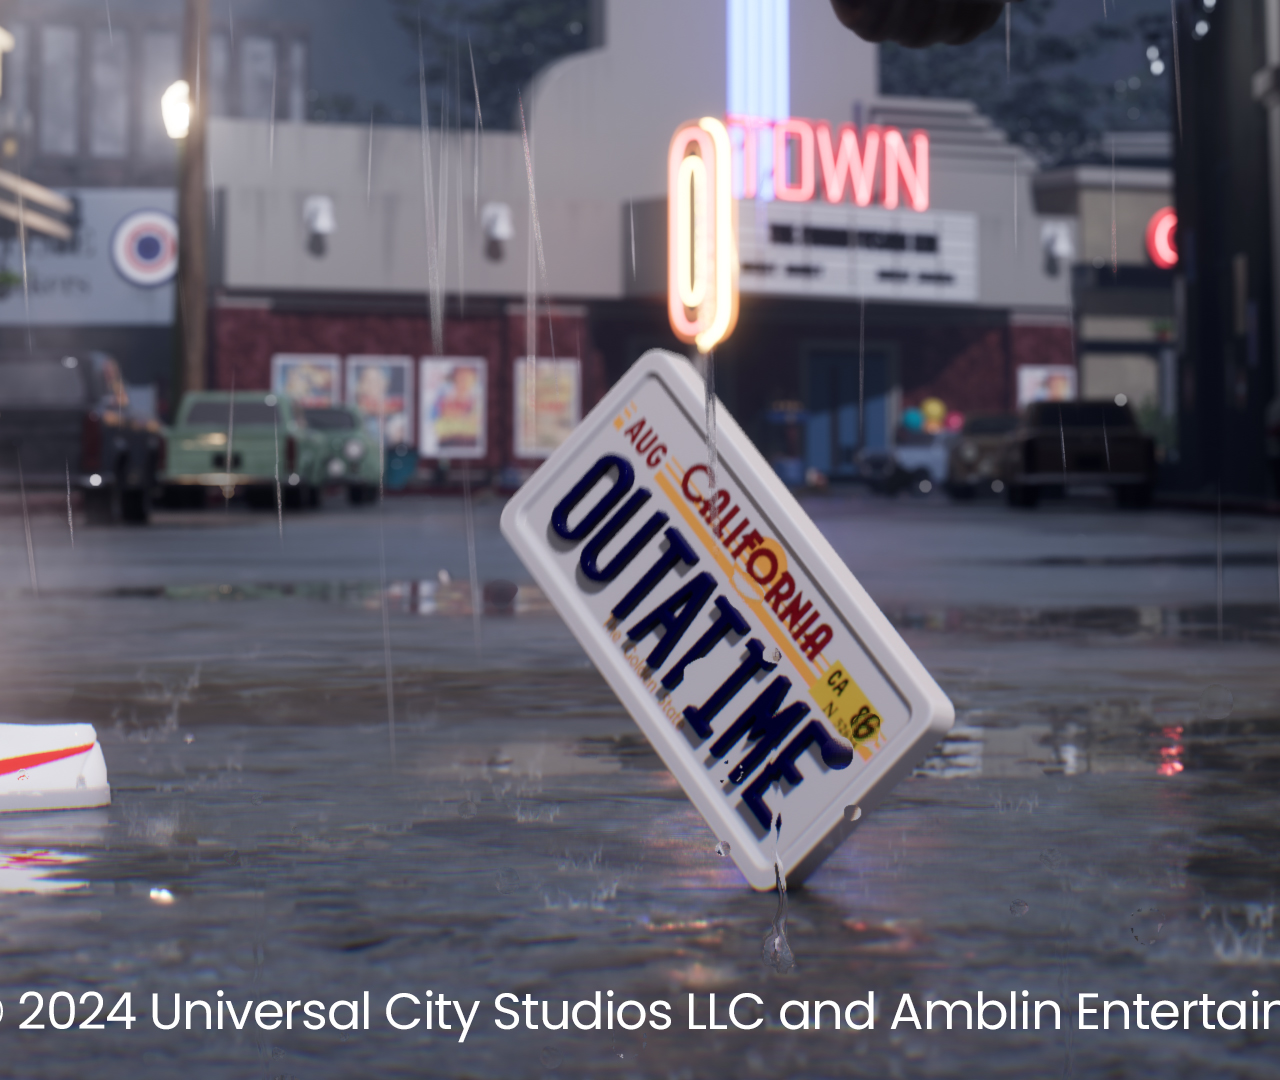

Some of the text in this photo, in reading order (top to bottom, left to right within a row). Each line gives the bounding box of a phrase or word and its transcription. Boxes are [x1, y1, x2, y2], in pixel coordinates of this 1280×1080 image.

[724, 113, 930, 212] TOWN
[624, 417, 668, 470] AUG
[681, 463, 835, 662] CALIFORNIA
[549, 454, 838, 832] OUTATIME
[827, 668, 849, 697] CA
